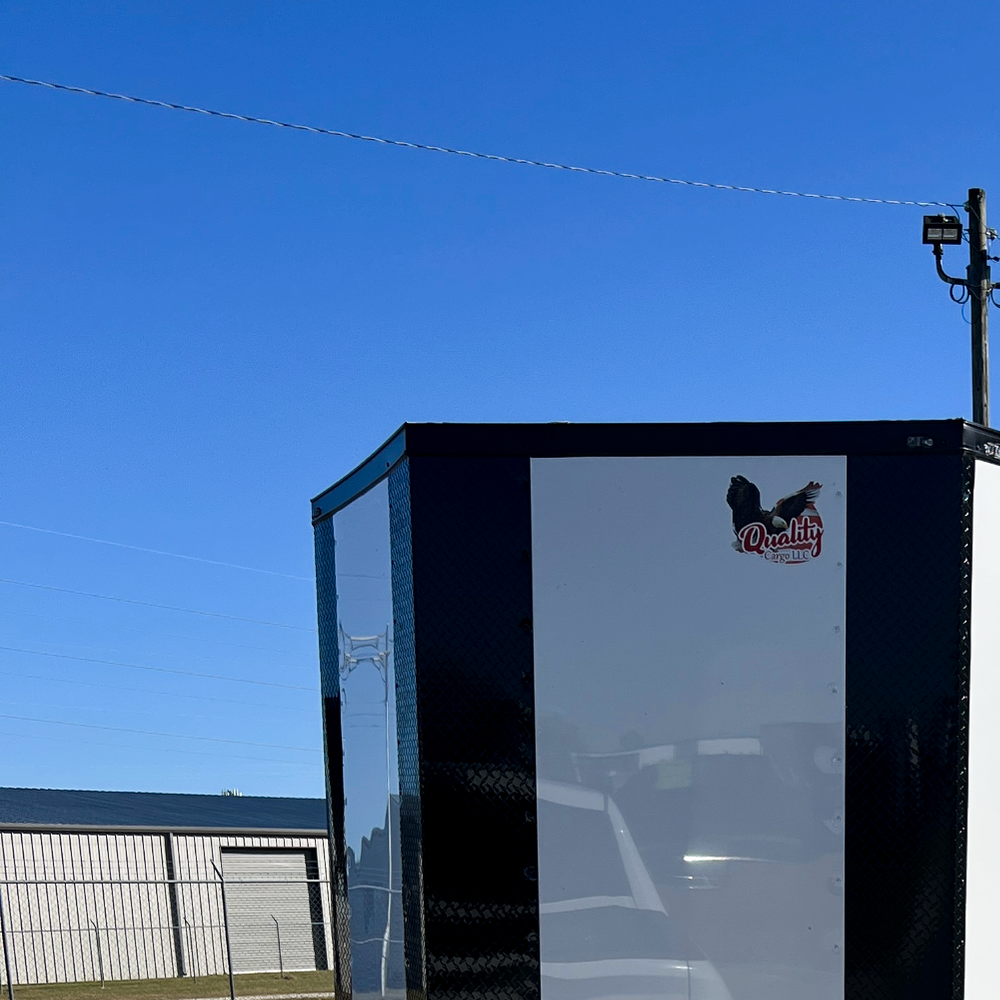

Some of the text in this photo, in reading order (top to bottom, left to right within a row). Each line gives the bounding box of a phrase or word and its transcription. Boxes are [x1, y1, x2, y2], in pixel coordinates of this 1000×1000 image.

[739, 517, 824, 557] Quality
[764, 550, 810, 563] Cargo LLC
